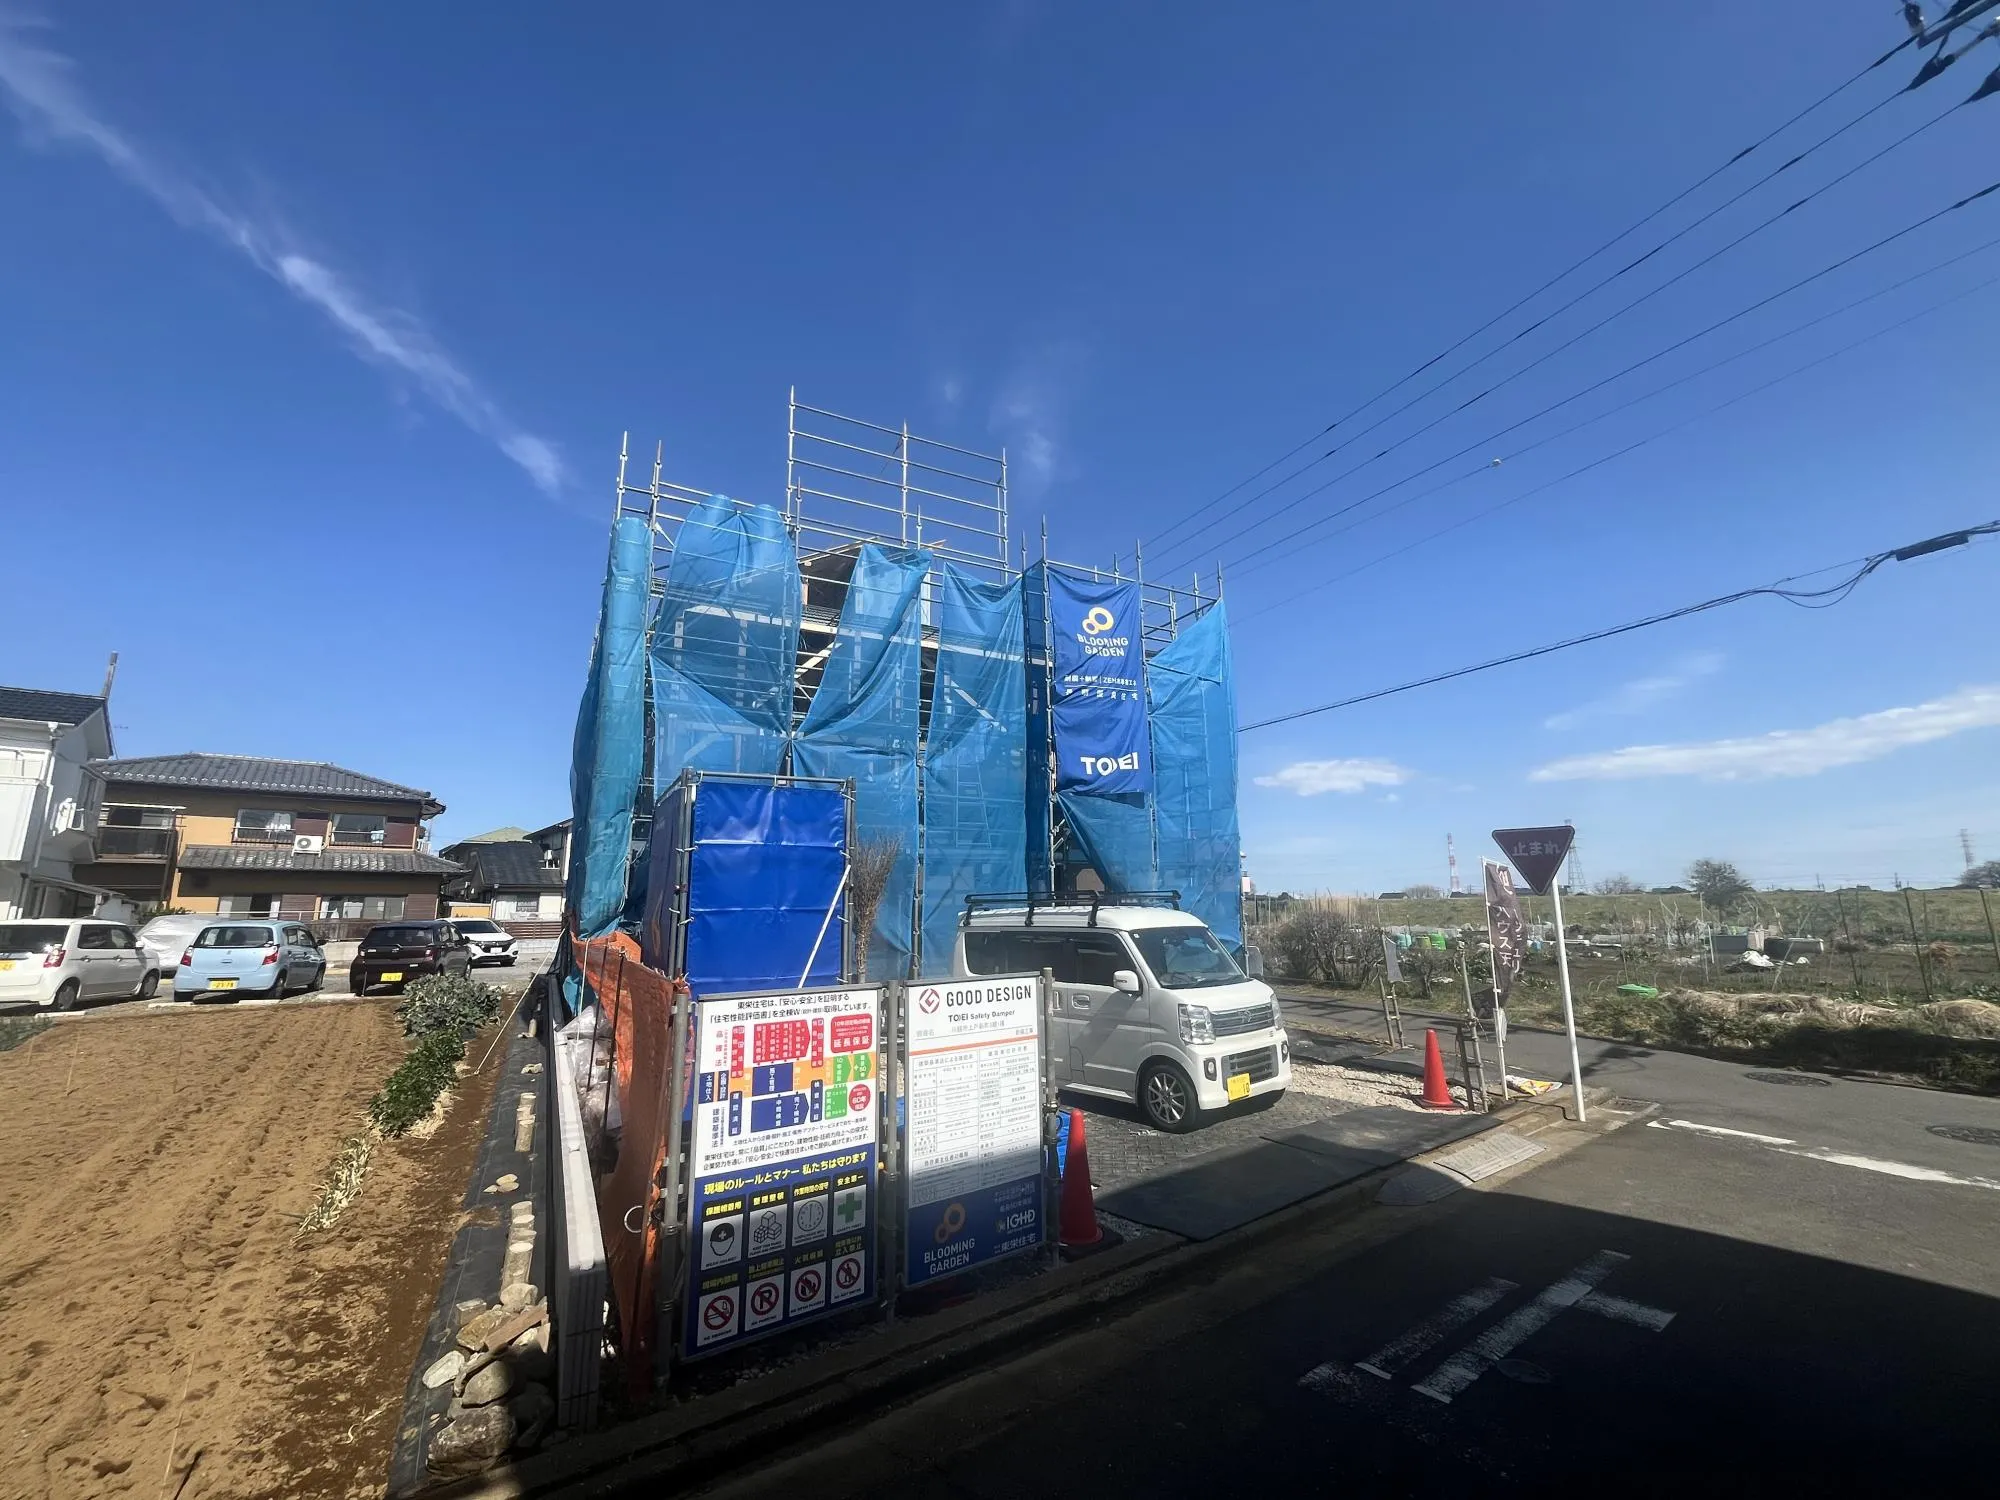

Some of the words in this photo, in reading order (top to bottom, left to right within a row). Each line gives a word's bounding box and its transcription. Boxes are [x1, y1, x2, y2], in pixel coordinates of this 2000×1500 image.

[1076, 633, 1129, 647] BLOOMING
[1080, 751, 1139, 776] TOEI
[1511, 840, 1562, 857] 止まれ
[946, 989, 982, 1007] GOOD
[987, 985, 1031, 1003] DESIGN
[948, 1013, 969, 1023] TOEI
[970, 1012, 990, 1021] Safety
[992, 1010, 1015, 1019] Damper
[704, 1169, 800, 1196] 現場のルールとマナー
[802, 1152, 868, 1176] 私たちは守ります
[837, 1175, 864, 1187] 安全第一
[924, 1238, 976, 1264] BLOOMING
[930, 1253, 970, 1275] GARDEN
